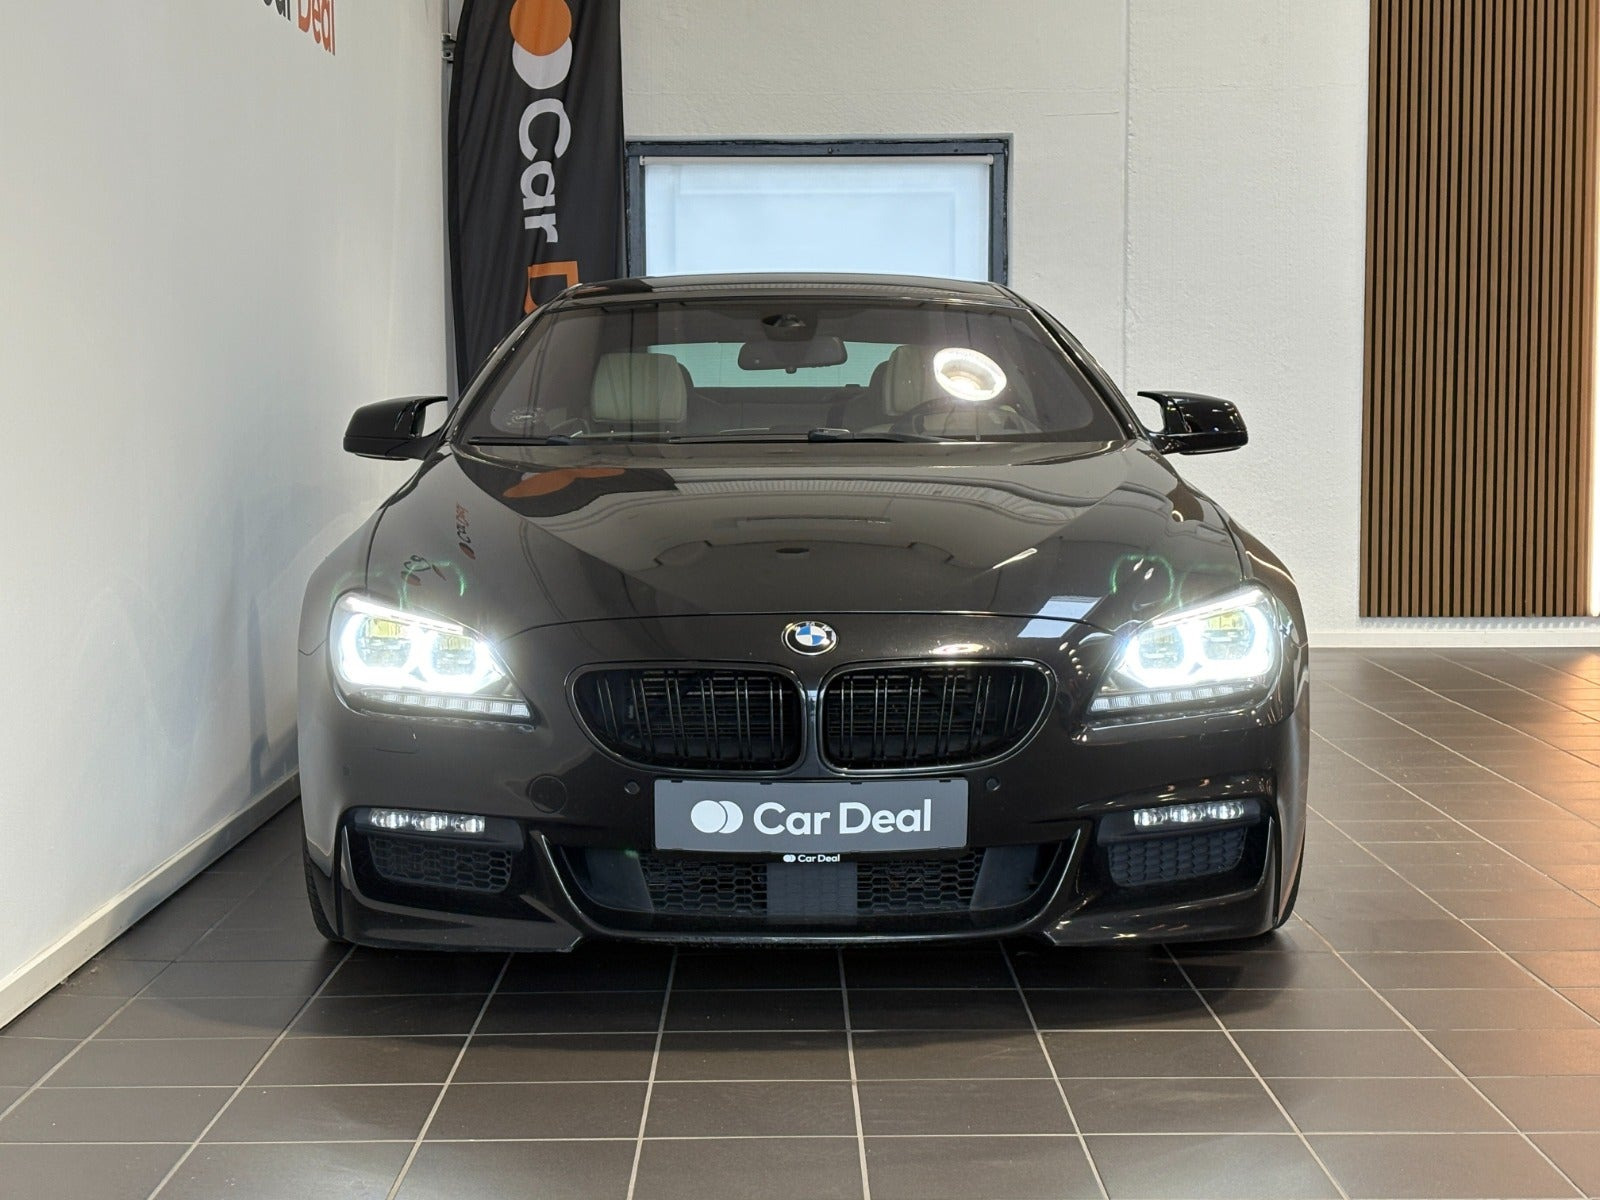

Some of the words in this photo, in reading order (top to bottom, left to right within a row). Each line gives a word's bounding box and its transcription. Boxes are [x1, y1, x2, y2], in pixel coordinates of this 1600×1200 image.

[518, 98, 572, 243] Car
[753, 801, 831, 835] Car
[839, 798, 932, 834] Deal
[797, 854, 817, 863] Car
[817, 853, 841, 863] Deal
